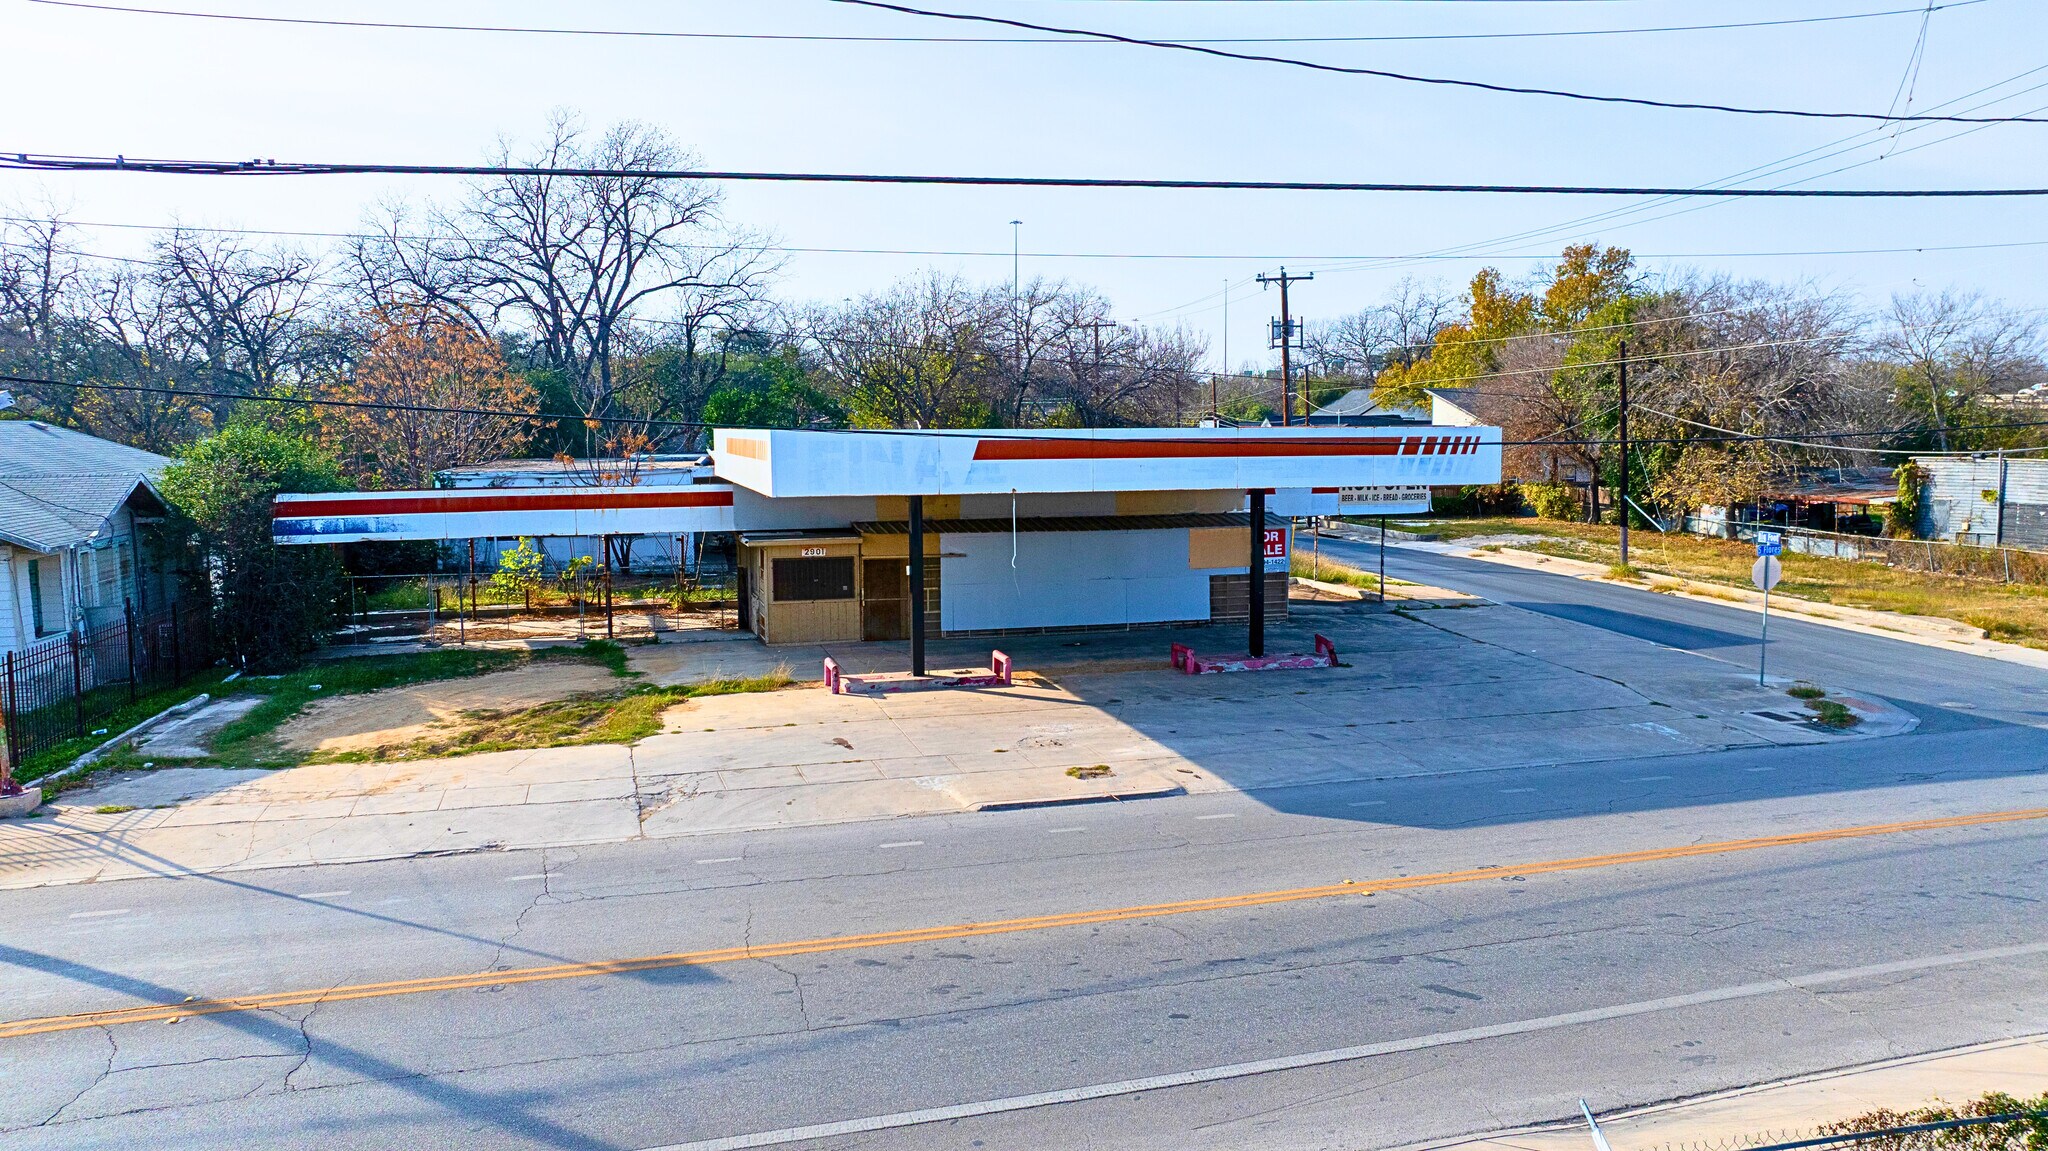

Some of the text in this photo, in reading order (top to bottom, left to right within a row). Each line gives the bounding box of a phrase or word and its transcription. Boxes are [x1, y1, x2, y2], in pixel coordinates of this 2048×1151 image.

[1341, 494, 1354, 502] BEER
[1357, 494, 1369, 502] MILK
[1383, 493, 1399, 501] BREAD
[1401, 493, 1427, 501] GROCERIES
[1264, 531, 1279, 542] OR
[804, 548, 825, 556] 2901
[1264, 544, 1283, 555] LE
